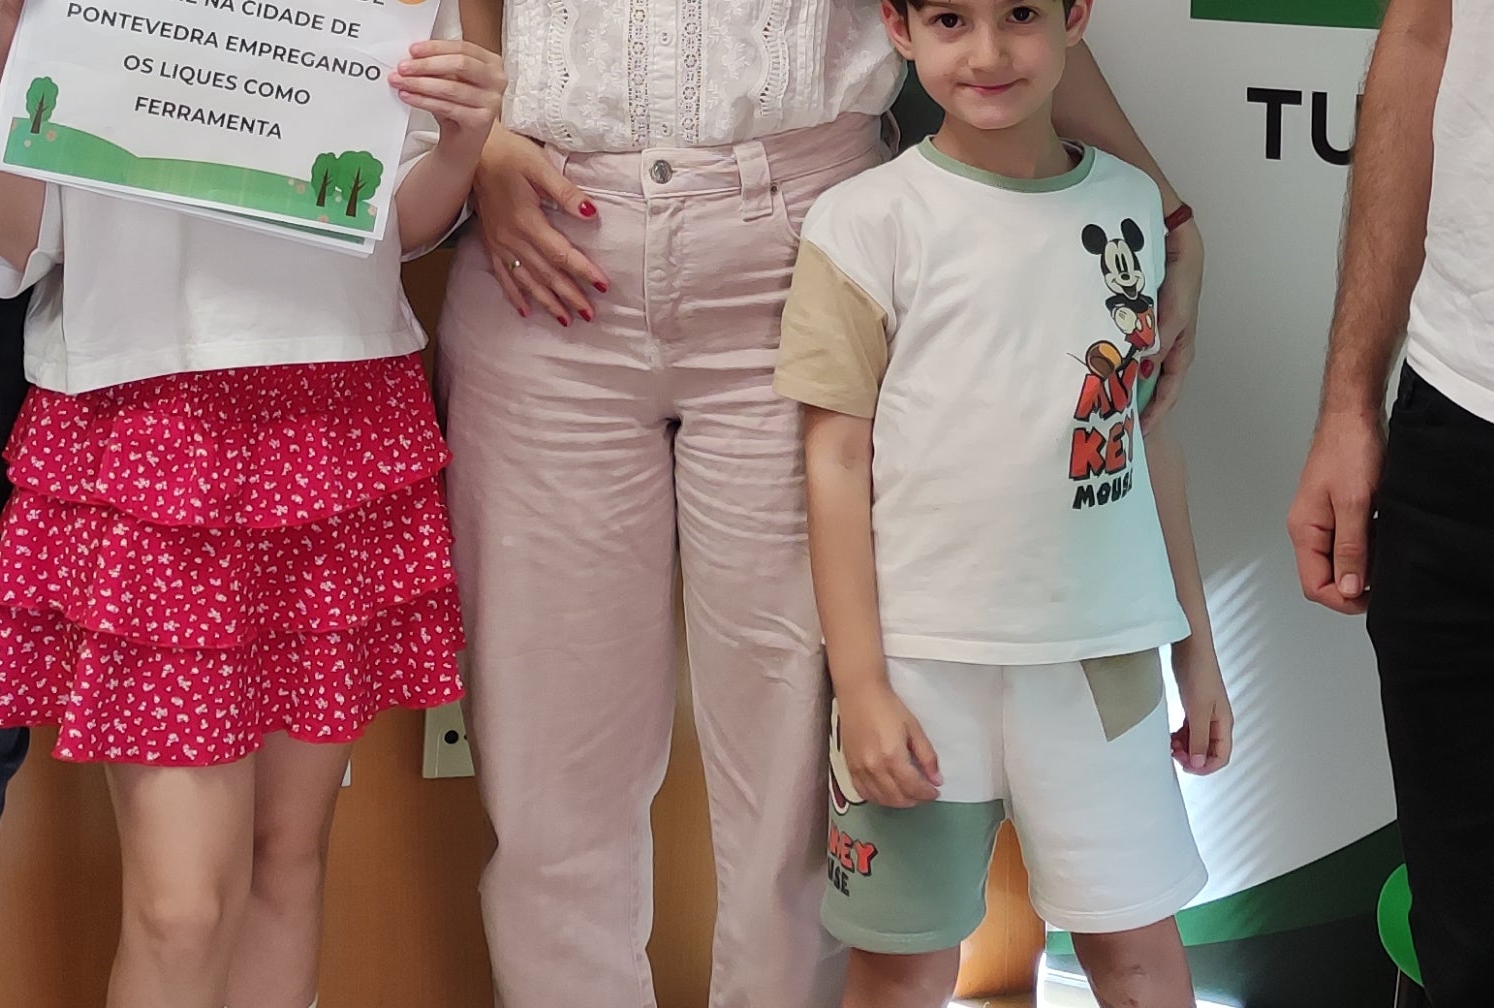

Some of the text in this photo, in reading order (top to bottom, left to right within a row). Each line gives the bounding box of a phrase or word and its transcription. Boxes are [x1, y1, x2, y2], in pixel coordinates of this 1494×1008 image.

[66, 1, 381, 81] PONTEVEDRA EMPREGANDO
[241, 0, 325, 31] CIDADE
[331, 18, 361, 39] DE
[123, 54, 311, 105] OS LIQUES COMO
[134, 95, 282, 139] FERRAMENTA
